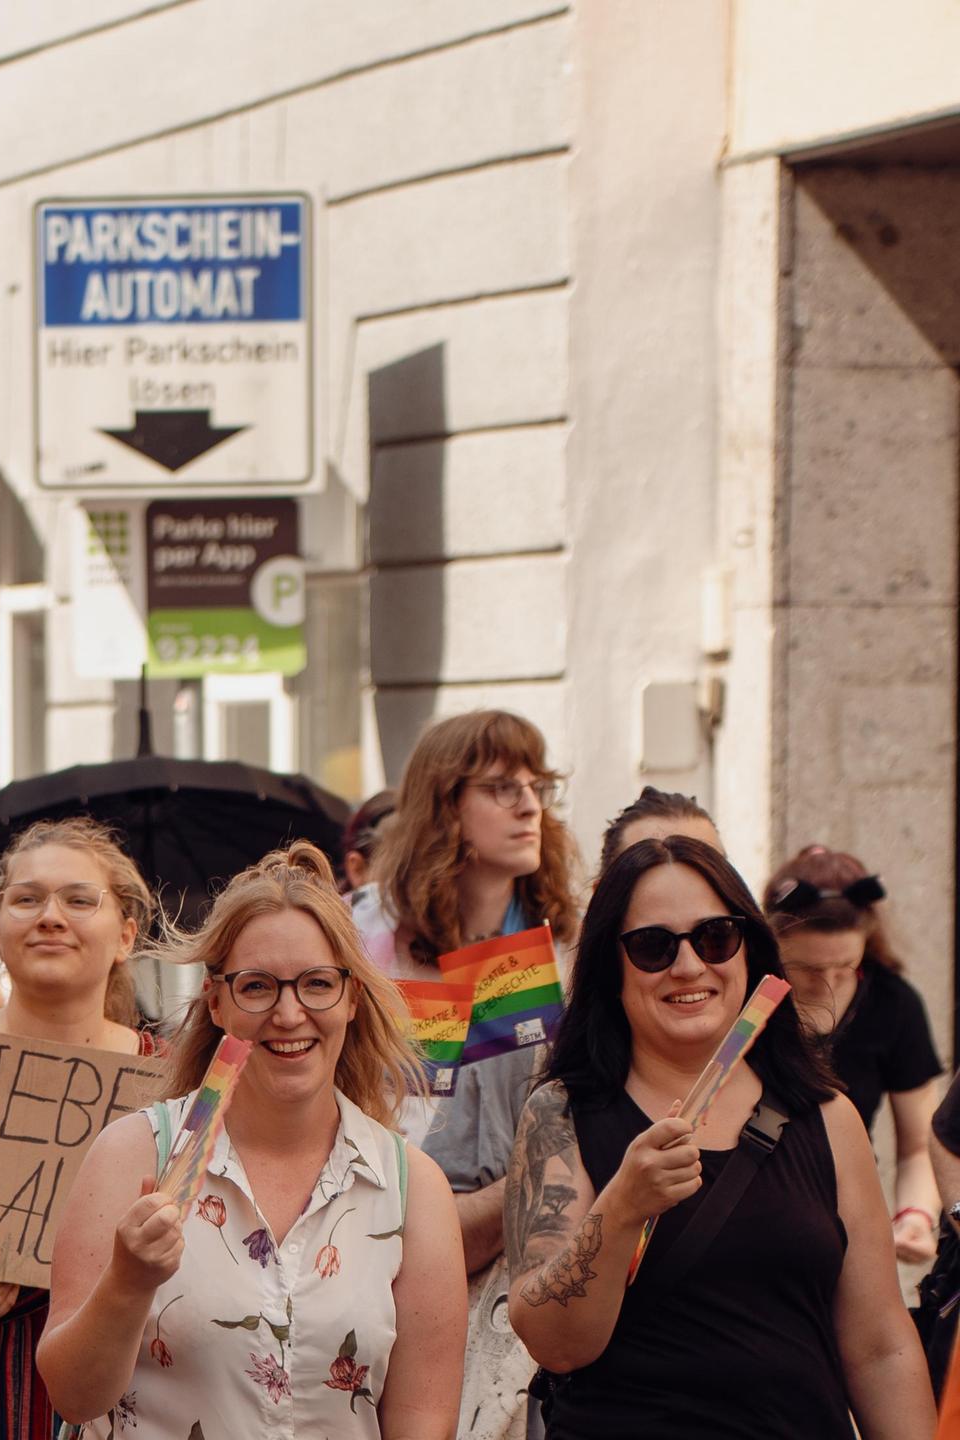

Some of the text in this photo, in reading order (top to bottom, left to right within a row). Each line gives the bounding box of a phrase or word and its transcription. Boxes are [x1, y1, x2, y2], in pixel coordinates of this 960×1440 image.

[46, 210, 300, 263] PARKSCHEIN-
[81, 268, 259, 321] AUTOMAT
[48, 336, 298, 367] Hier Parkschein
[130, 379, 215, 404] lösen
[153, 513, 277, 540] Parke hier
[153, 541, 256, 572] per App
[272, 576, 296, 608] P
